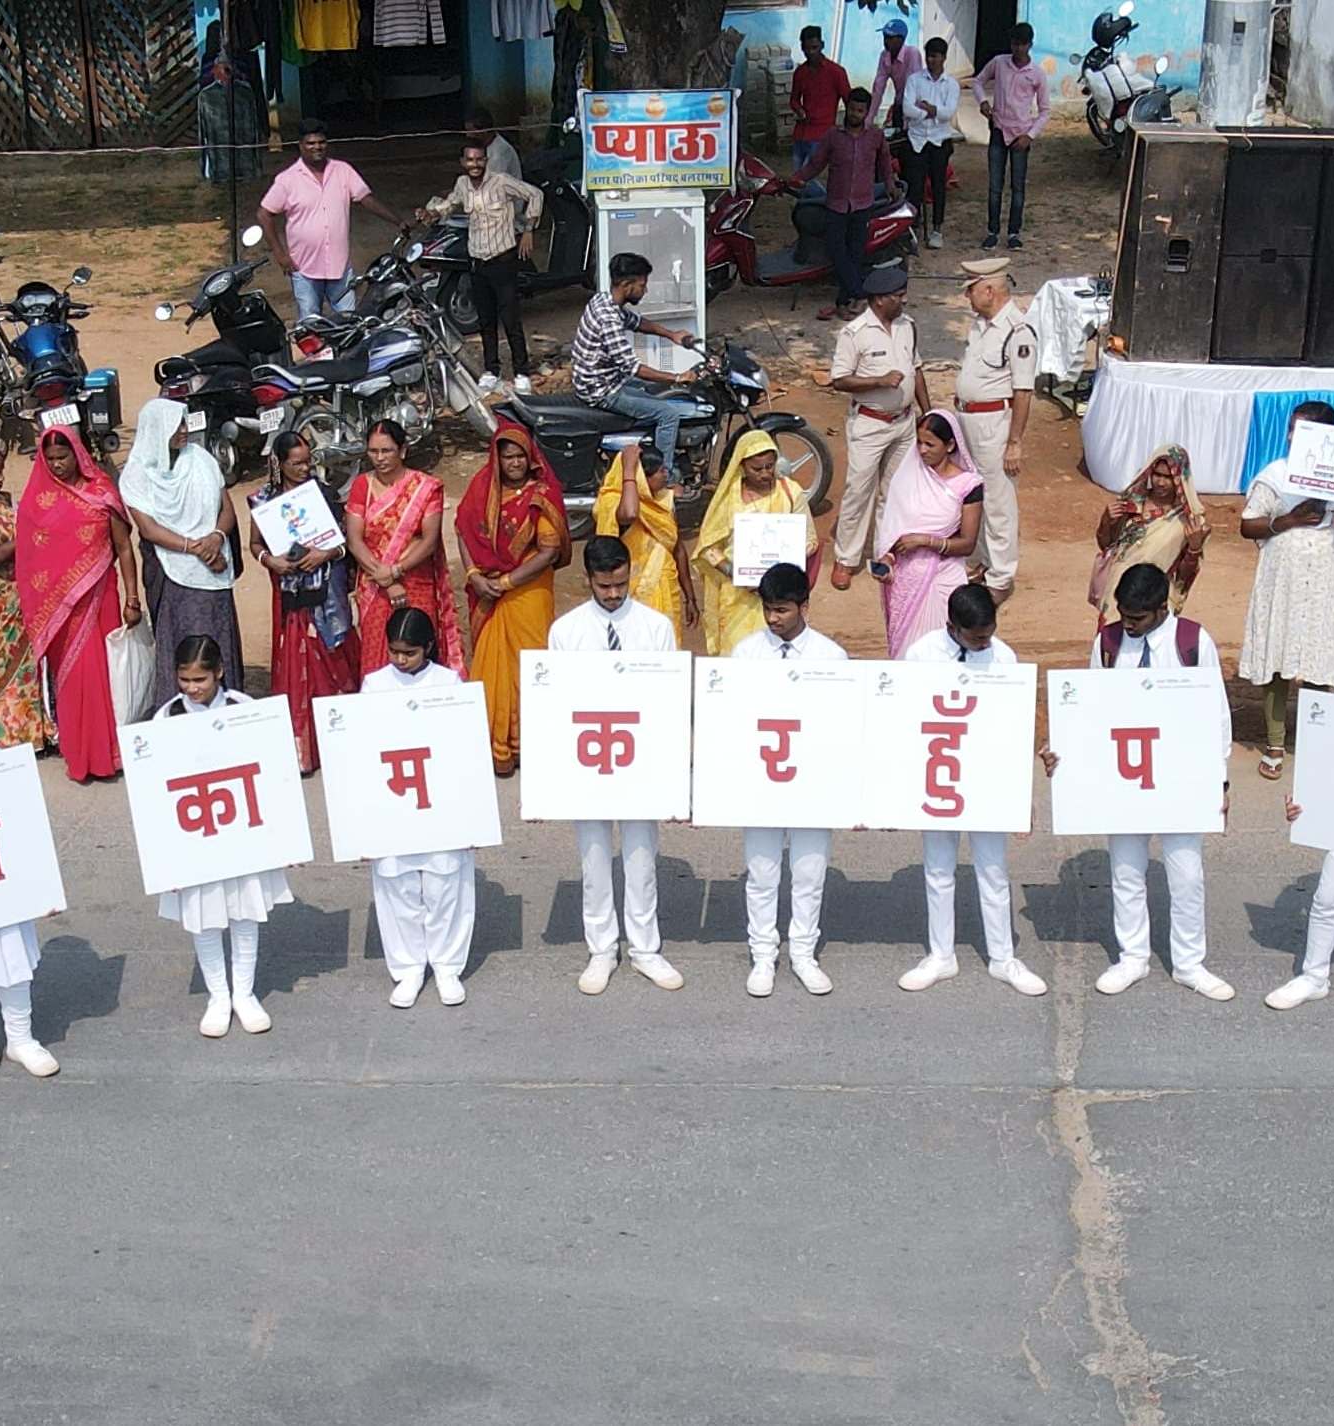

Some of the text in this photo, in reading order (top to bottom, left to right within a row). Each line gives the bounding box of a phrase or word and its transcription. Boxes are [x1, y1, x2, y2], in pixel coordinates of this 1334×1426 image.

[591, 122, 721, 162] प्याऊ
[572, 711, 640, 774] क
[758, 719, 801, 782] र
[921, 690, 977, 818] हुँ
[1110, 727, 1160, 789] प
[166, 762, 263, 837] का
[380, 747, 431, 810] म
